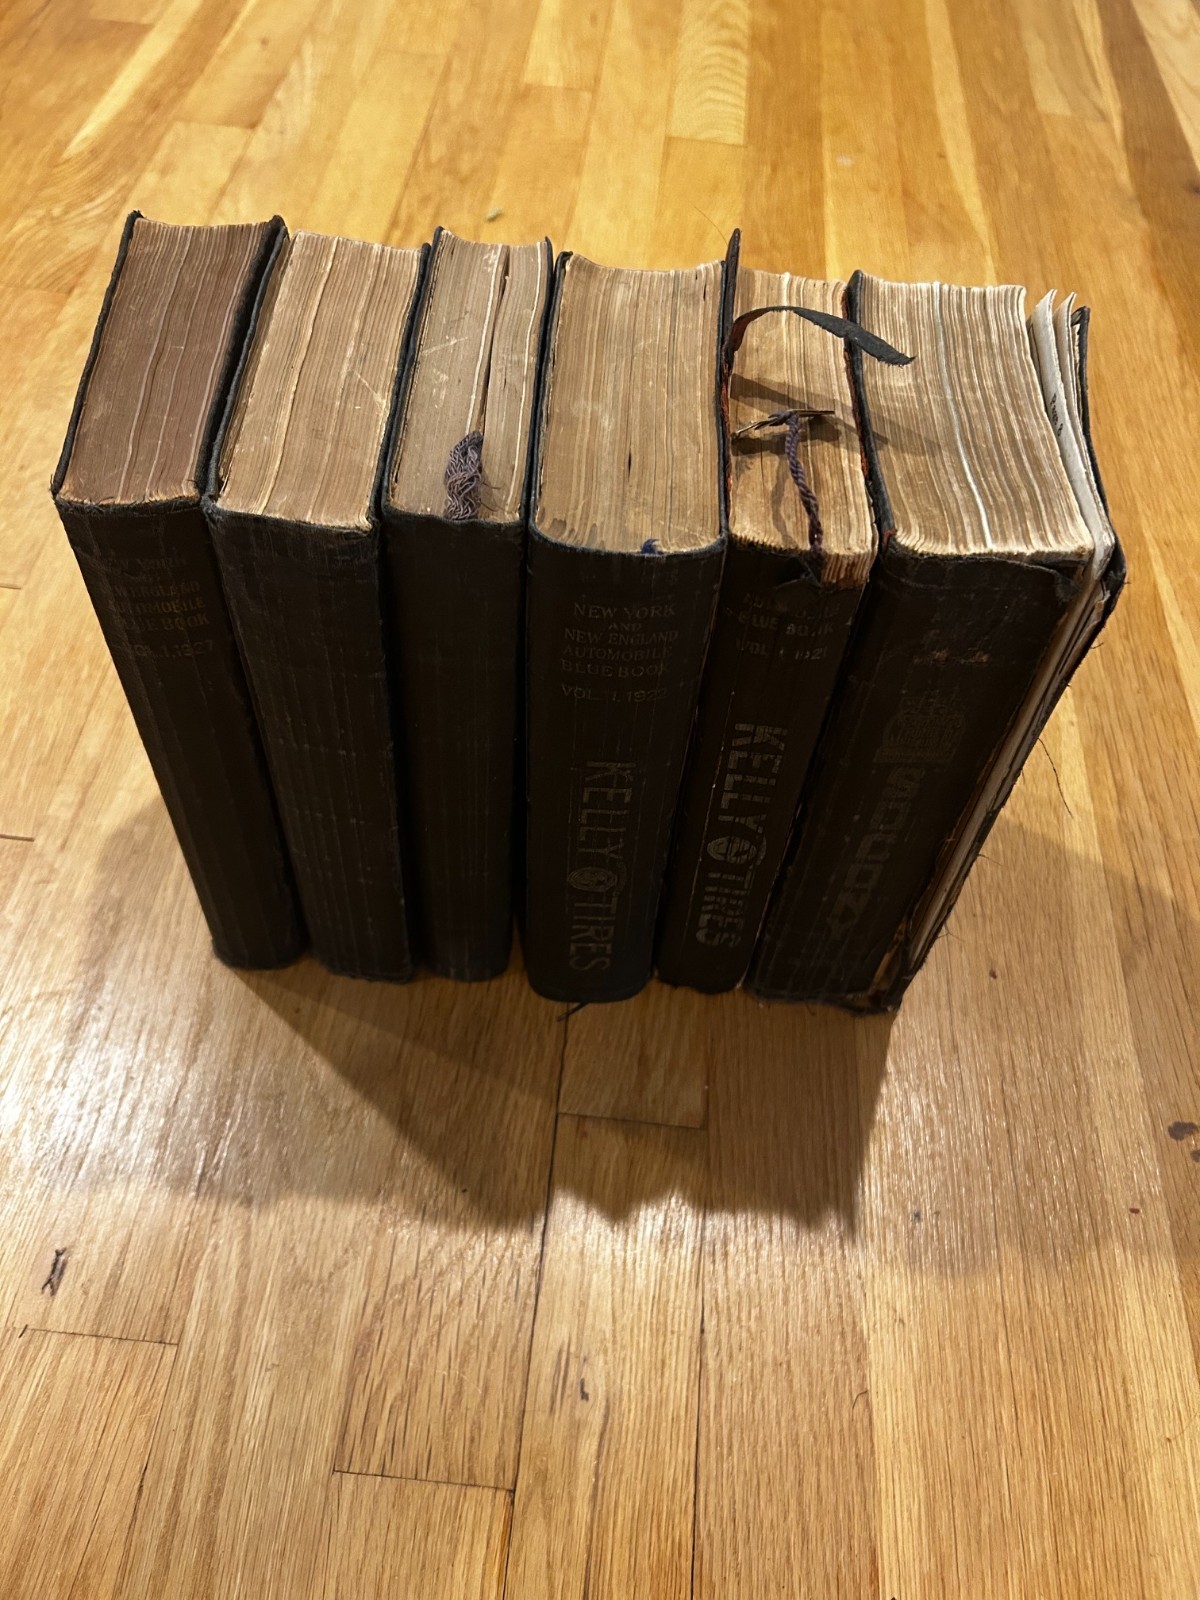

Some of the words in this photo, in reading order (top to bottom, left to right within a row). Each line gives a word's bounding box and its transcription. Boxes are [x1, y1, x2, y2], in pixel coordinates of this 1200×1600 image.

[109, 597, 206, 615] UTOMOBILE
[573, 602, 617, 619] NEW
[623, 603, 676, 620] YORK
[162, 613, 210, 631] BOOK
[608, 622, 642, 632] AND
[564, 628, 603, 644] NEW
[608, 630, 679, 646] ENGLAND
[562, 644, 673, 662] AUTOMOBILE
[560, 658, 613, 677] BLUE
[618, 662, 672, 678] BOOK
[627, 687, 668, 703] 1922
[718, 723, 788, 834] KELLY
[577, 761, 637, 860] KELLY
[696, 866, 755, 947] TIRES
[568, 895, 618, 971] TIRES
